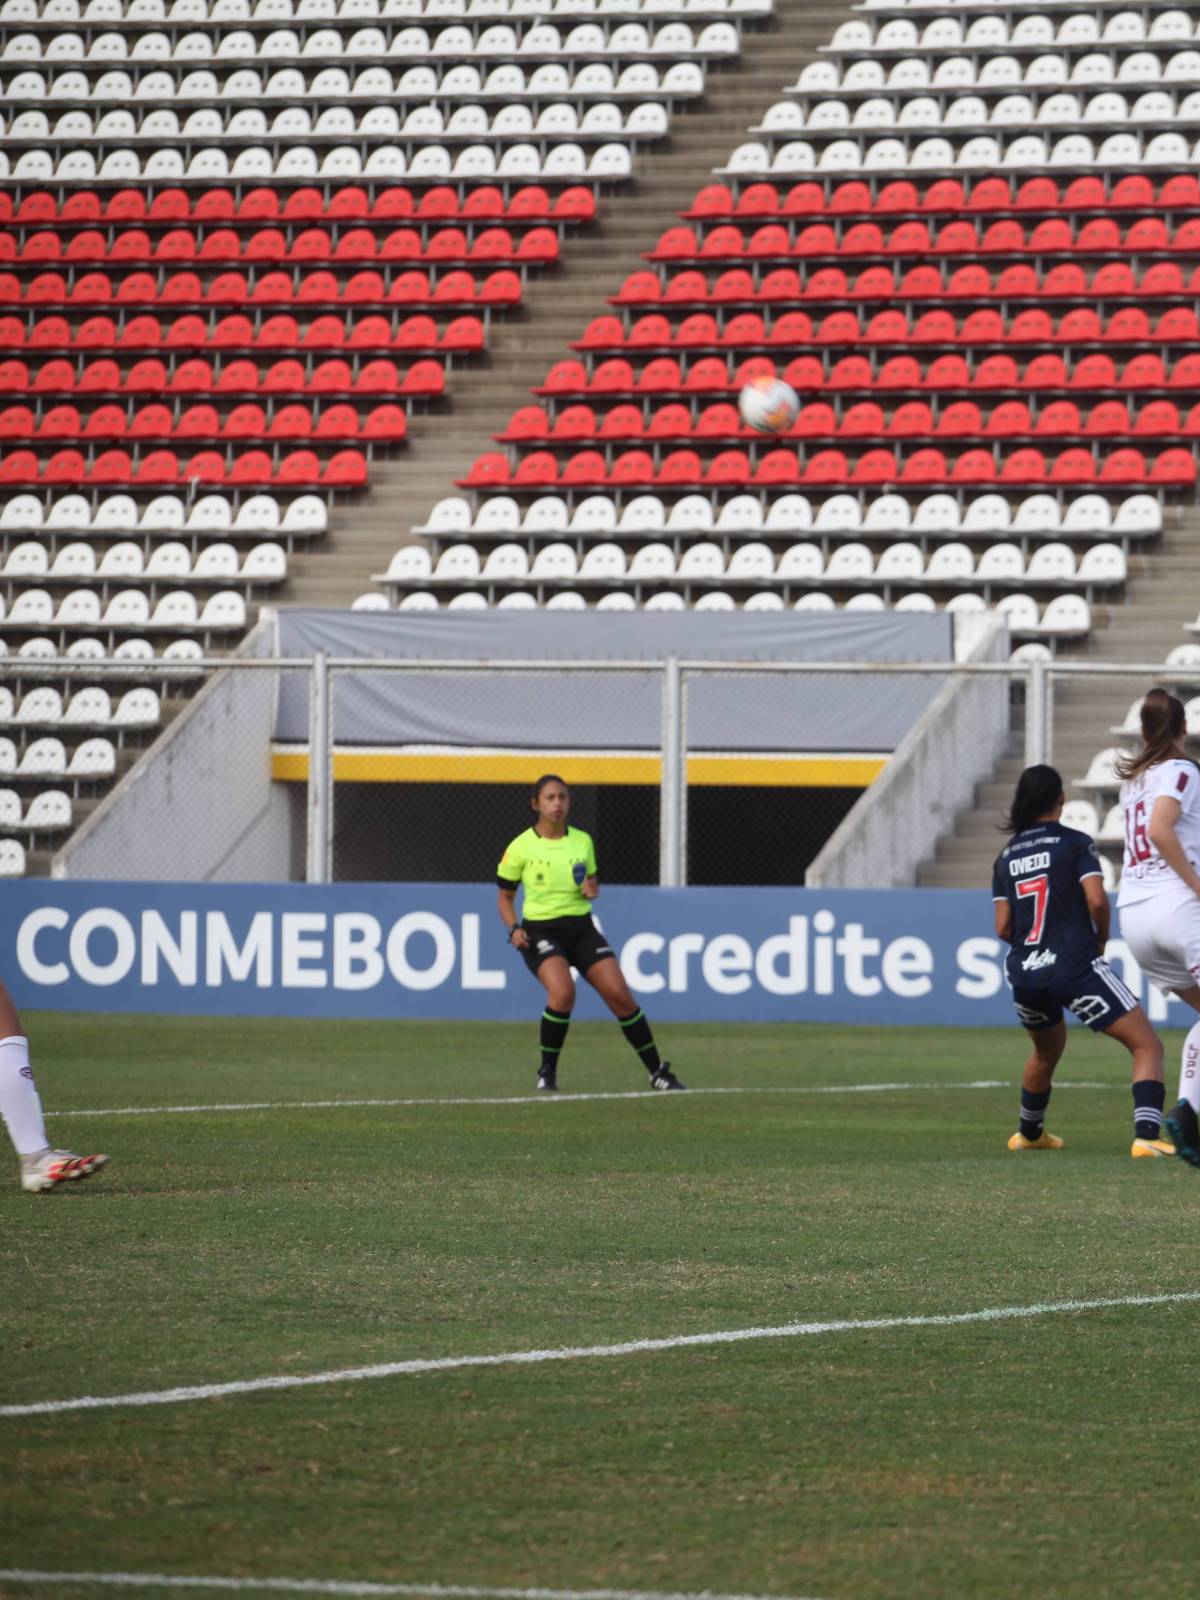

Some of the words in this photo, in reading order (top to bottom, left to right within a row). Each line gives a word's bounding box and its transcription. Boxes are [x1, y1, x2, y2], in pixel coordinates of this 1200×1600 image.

[1009, 851, 1051, 876] OVIEDO
[1015, 873, 1049, 946] 7
[16, 906, 506, 991] CONMEBOL
[569, 908, 935, 999] credite
